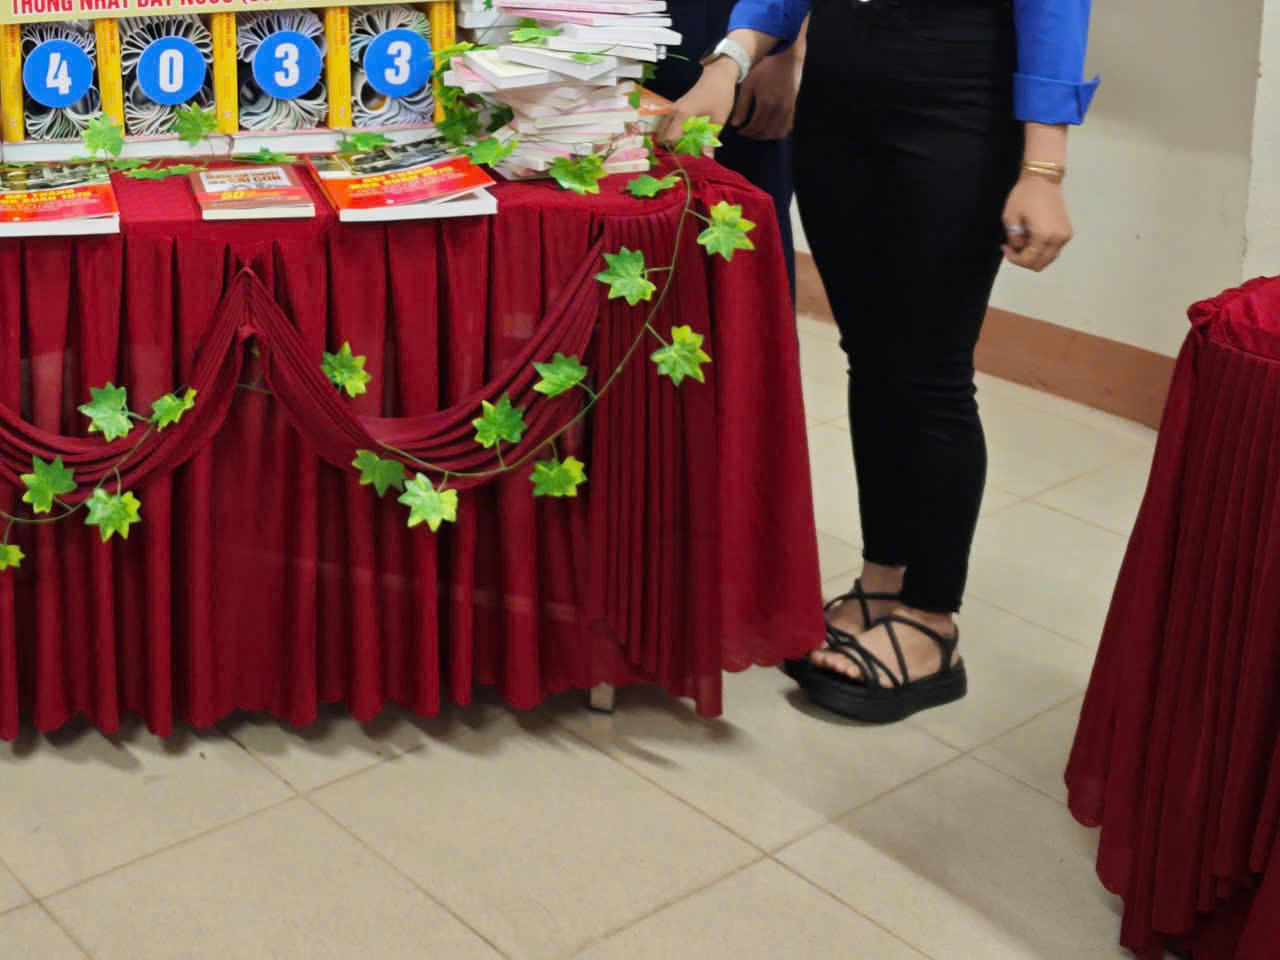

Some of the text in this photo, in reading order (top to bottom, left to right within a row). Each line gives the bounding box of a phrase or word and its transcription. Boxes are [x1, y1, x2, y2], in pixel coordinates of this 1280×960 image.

[46, 40, 413, 96] 4 0 3 3
